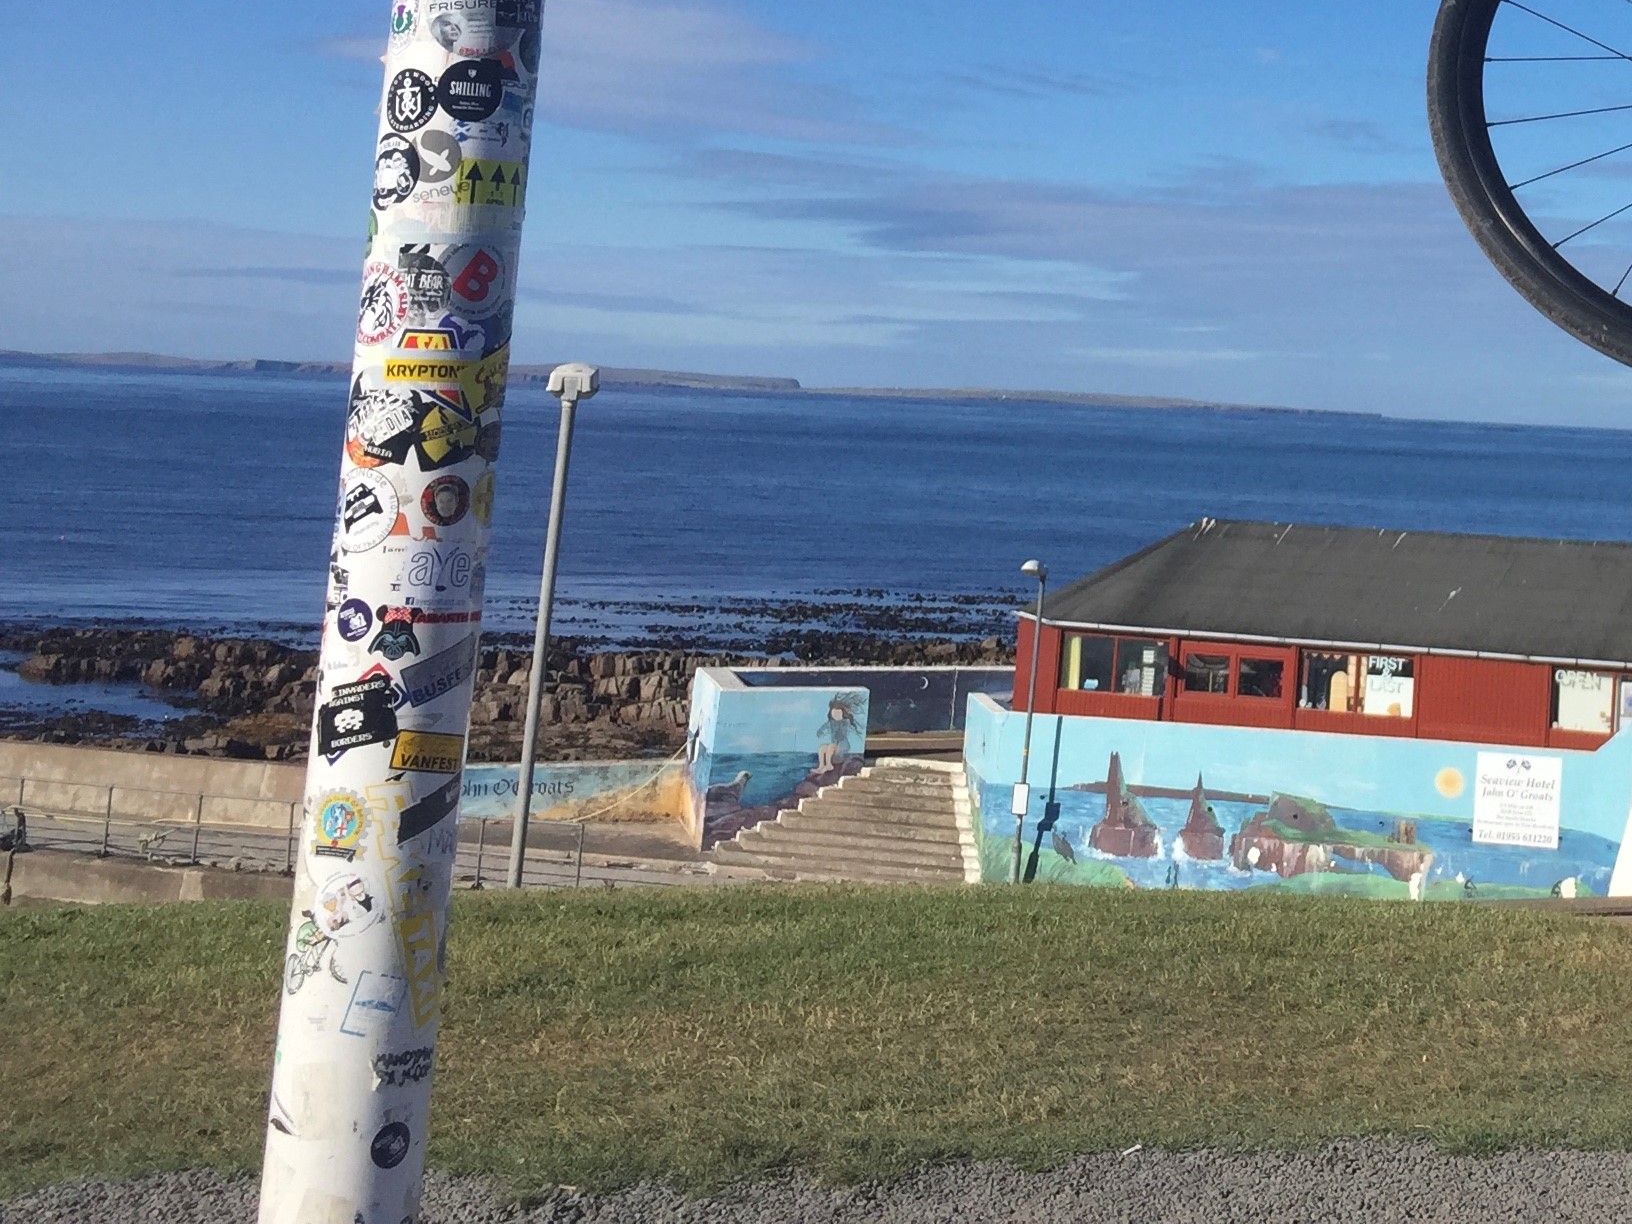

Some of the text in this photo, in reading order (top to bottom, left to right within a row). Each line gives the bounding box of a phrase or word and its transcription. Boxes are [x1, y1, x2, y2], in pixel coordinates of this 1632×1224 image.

[449, 80, 492, 98] SHILLING
[386, 364, 466, 380] KRYPTON
[1367, 655, 1406, 672] FIRST
[1555, 668, 1602, 689] OPEN
[338, 680, 386, 698] INVADERS
[328, 692, 366, 708] AGAINST
[330, 731, 373, 749] BORDERS
[400, 753, 458, 771] VANFEST
[1480, 773, 1556, 791] Seaview Hotel
[1482, 786, 1504, 798] John
[1520, 788, 1554, 802] Groats
[1496, 830, 1521, 842] 01955
